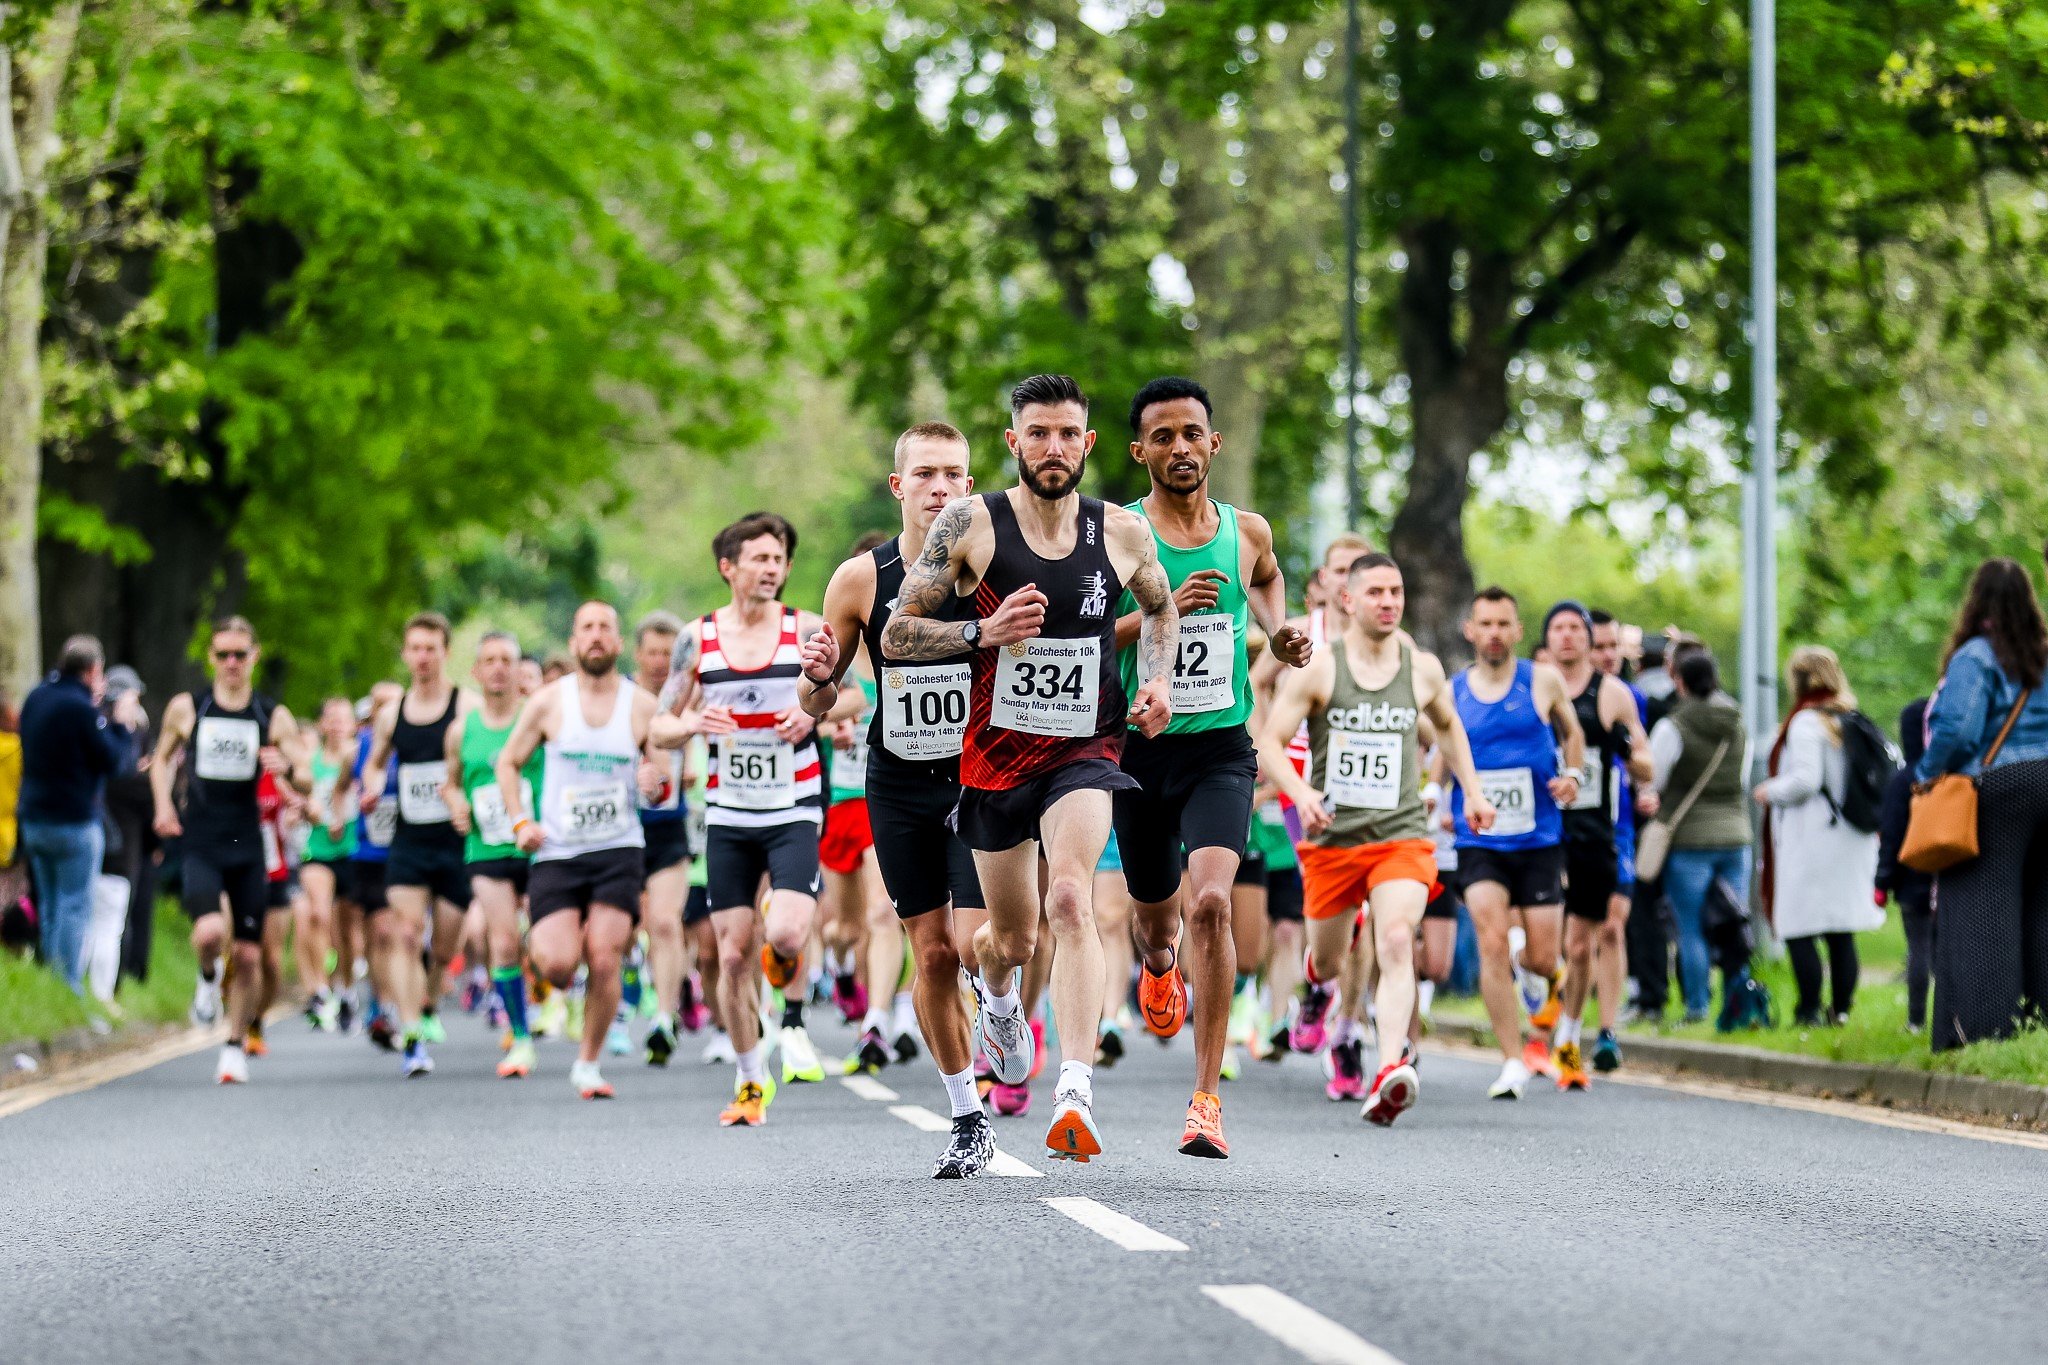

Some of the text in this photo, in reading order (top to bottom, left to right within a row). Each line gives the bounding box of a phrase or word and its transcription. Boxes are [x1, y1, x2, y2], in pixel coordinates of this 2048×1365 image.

[1087, 517, 1095, 545] soar
[1028, 646, 1095, 656] Colchester 10k
[906, 672, 972, 684] Colchester 10k
[1012, 662, 1083, 700] 334
[1173, 677, 1226, 690] May 14th 2023
[898, 690, 965, 726] 100
[1000, 696, 1090, 712] Sunday May 14th 2023
[1016, 712, 1072, 724] LKA Recruitment
[1327, 701, 1417, 731] adidas
[890, 730, 917, 738] Sunday
[920, 730, 936, 738] May
[938, 728, 954, 736] 14th
[922, 742, 960, 750] Recruitment
[730, 754, 776, 780] 561
[1339, 752, 1388, 780] 515
[1483, 789, 1522, 809] 20
[572, 802, 616, 828] 599
